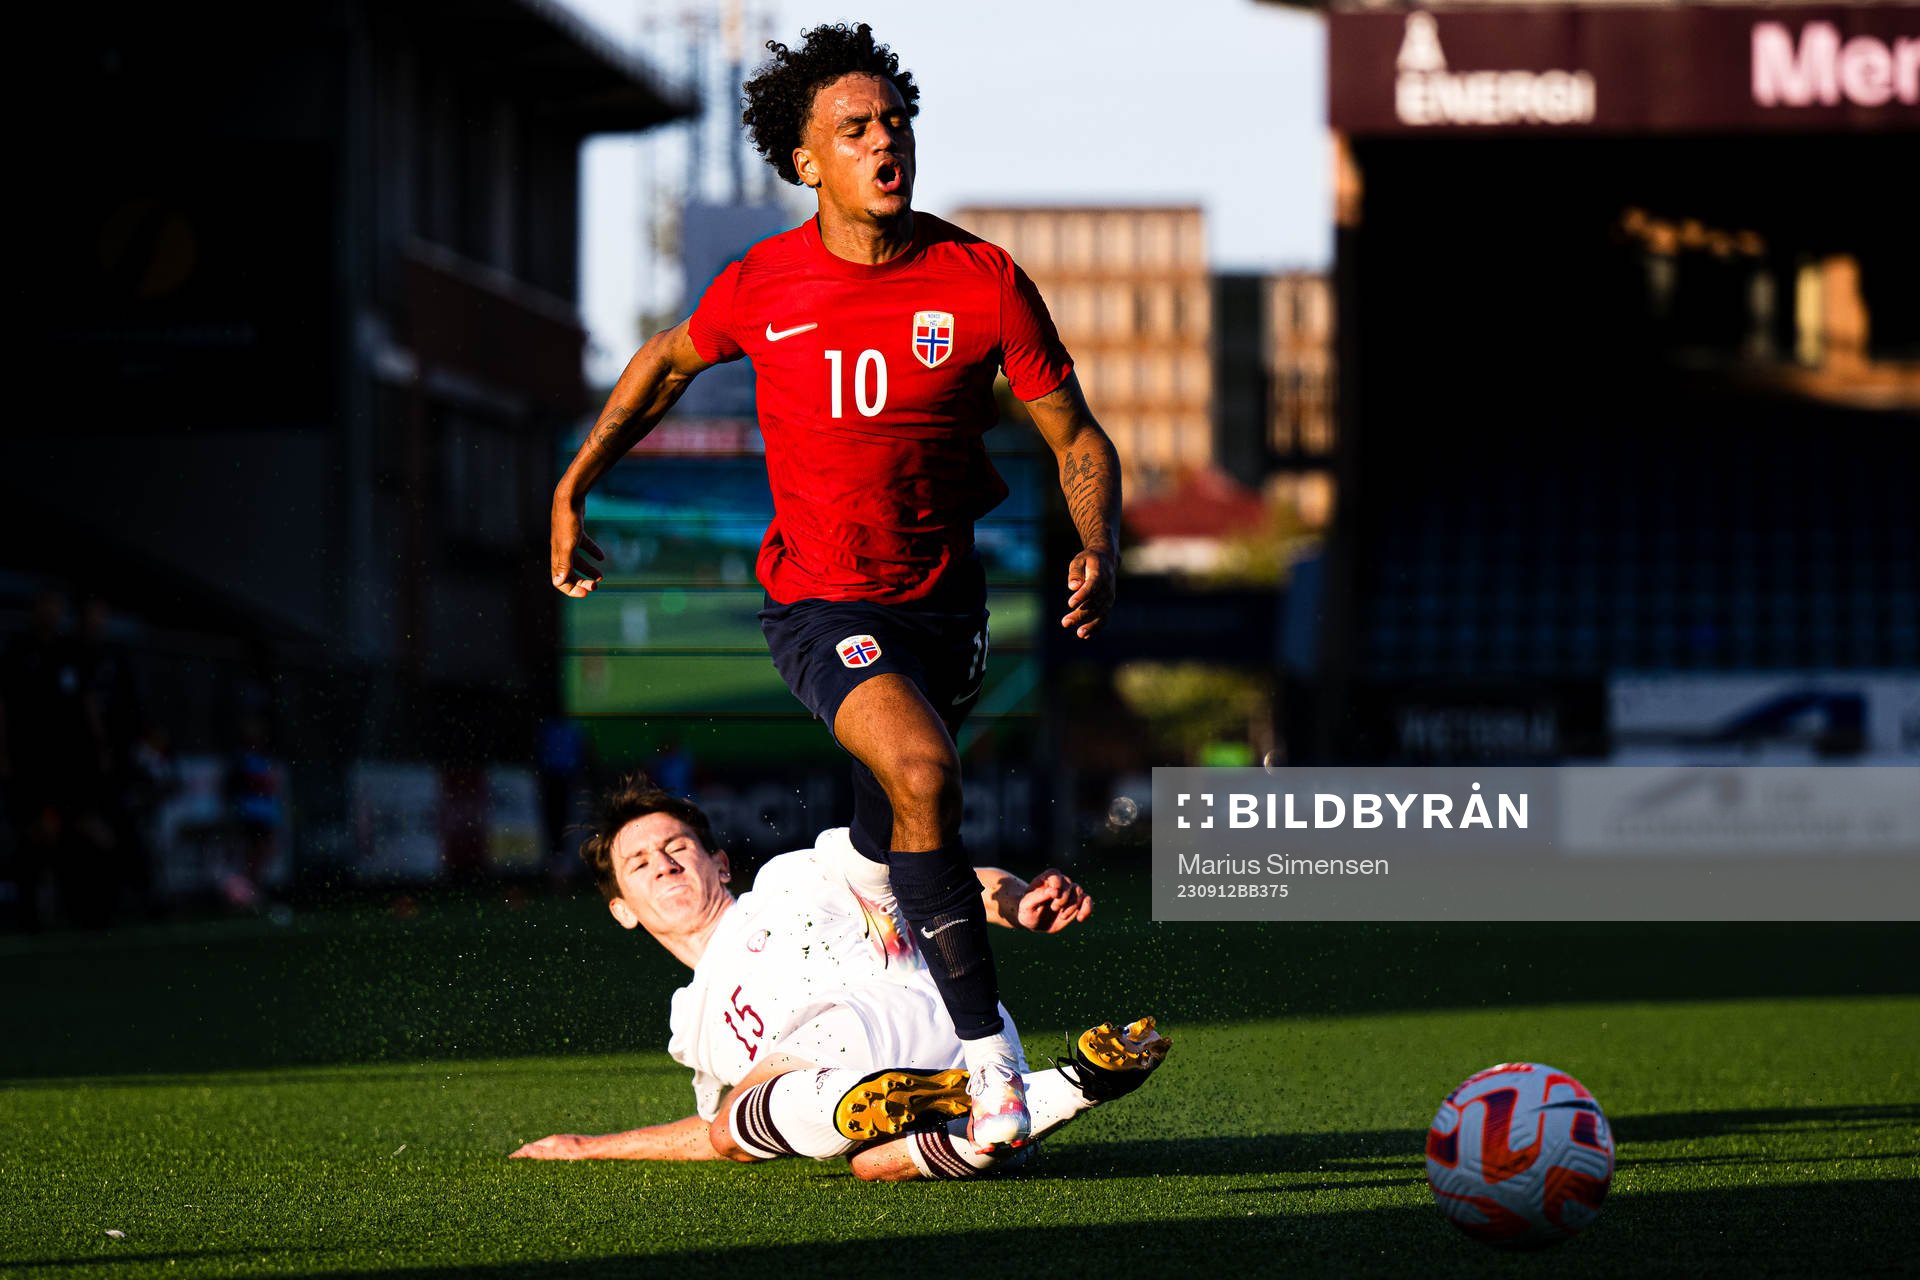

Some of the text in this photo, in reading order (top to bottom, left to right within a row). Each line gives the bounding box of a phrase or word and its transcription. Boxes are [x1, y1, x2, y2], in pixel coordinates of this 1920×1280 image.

[1396, 71, 1596, 125] ENERGI
[824, 348, 888, 419] 10
[968, 621, 990, 680] 1
[724, 985, 765, 1062] 15
